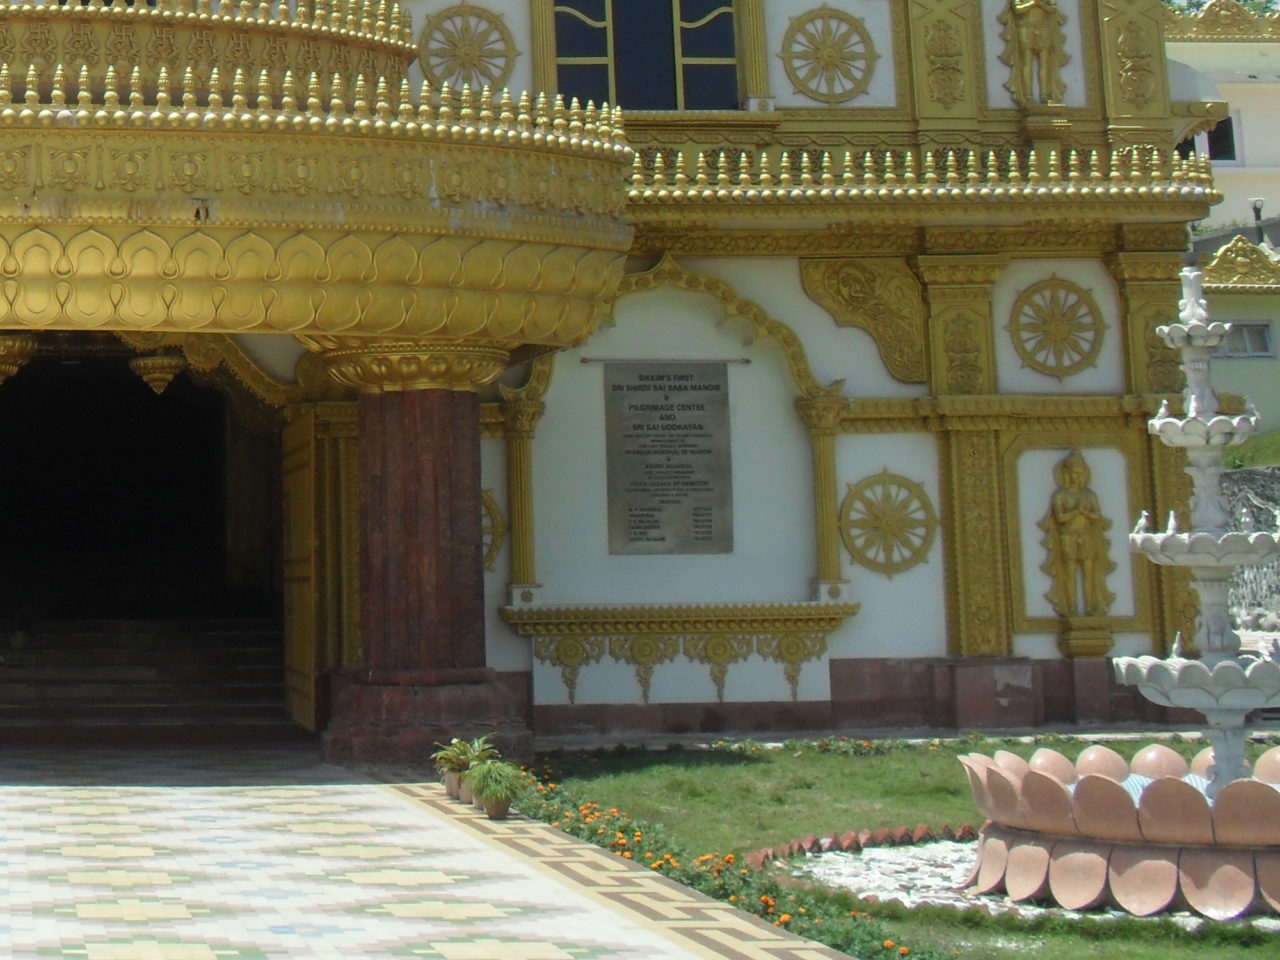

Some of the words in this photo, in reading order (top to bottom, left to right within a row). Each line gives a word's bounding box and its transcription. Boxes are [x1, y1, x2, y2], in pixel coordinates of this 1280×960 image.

[628, 403, 674, 411] PILGRIMAGE
[676, 403, 705, 411] CENTRE
[632, 423, 645, 431] SRI
[647, 423, 659, 431] SAI
